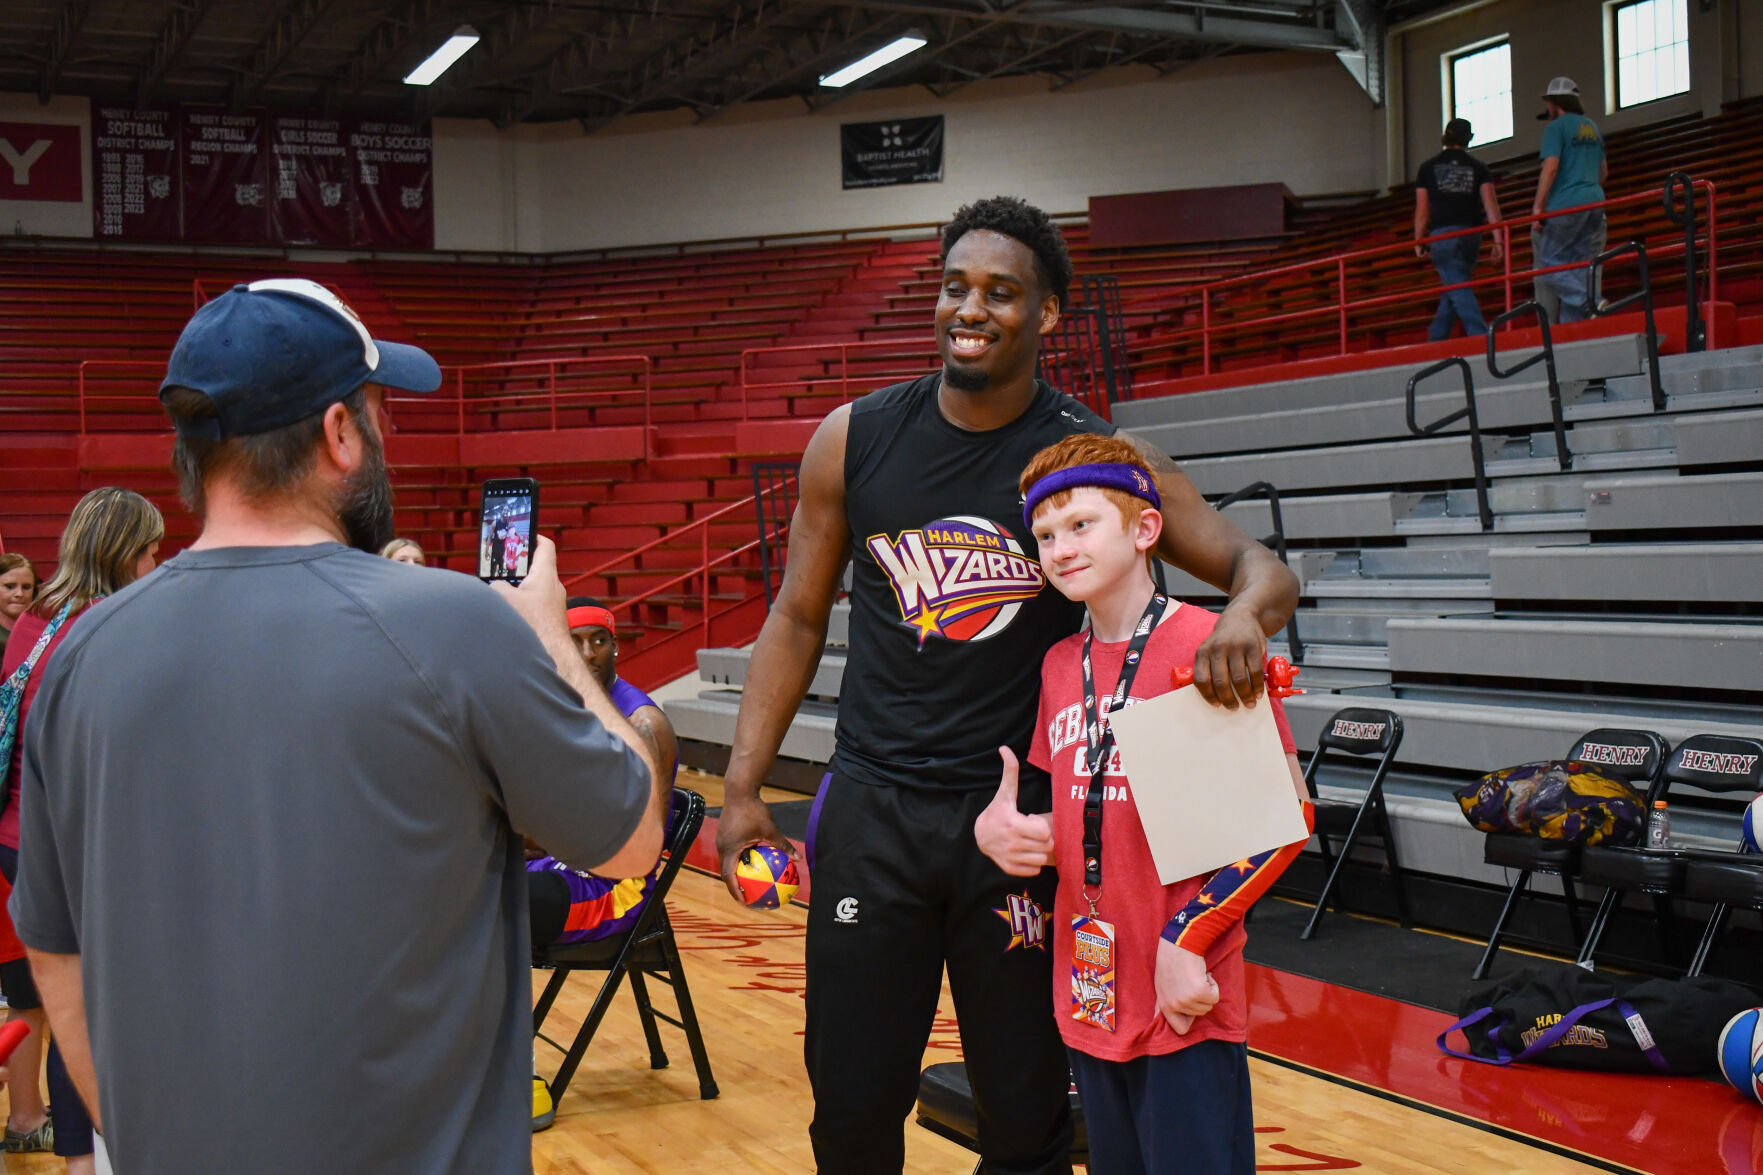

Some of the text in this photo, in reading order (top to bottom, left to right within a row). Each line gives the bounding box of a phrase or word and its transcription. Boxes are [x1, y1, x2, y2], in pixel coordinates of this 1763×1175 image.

[107, 121, 165, 137] SOFTBALL
[202, 126, 246, 141] SOFTBALL
[281, 130, 338, 144] GIRLS SOCCER
[97, 137, 175, 151] DISTRICT CHAMPS
[191, 141, 257, 154] REGION CHAMPS
[351, 134, 432, 150] BOYS SOCCER
[273, 144, 346, 157] DISTRICT CHAMPS
[357, 149, 427, 163] DISTRICT CHAMPS
[927, 529, 1001, 548] HARLEM
[868, 531, 1044, 612] WIZARDS
[1331, 719, 1386, 740] HENRY
[1579, 743, 1649, 765] HENRY
[1679, 749, 1758, 774] HENRY
[1653, 829, 1662, 839] G
[1075, 930, 1110, 947] COURTSIDE
[1075, 940, 1111, 968] PLUS
